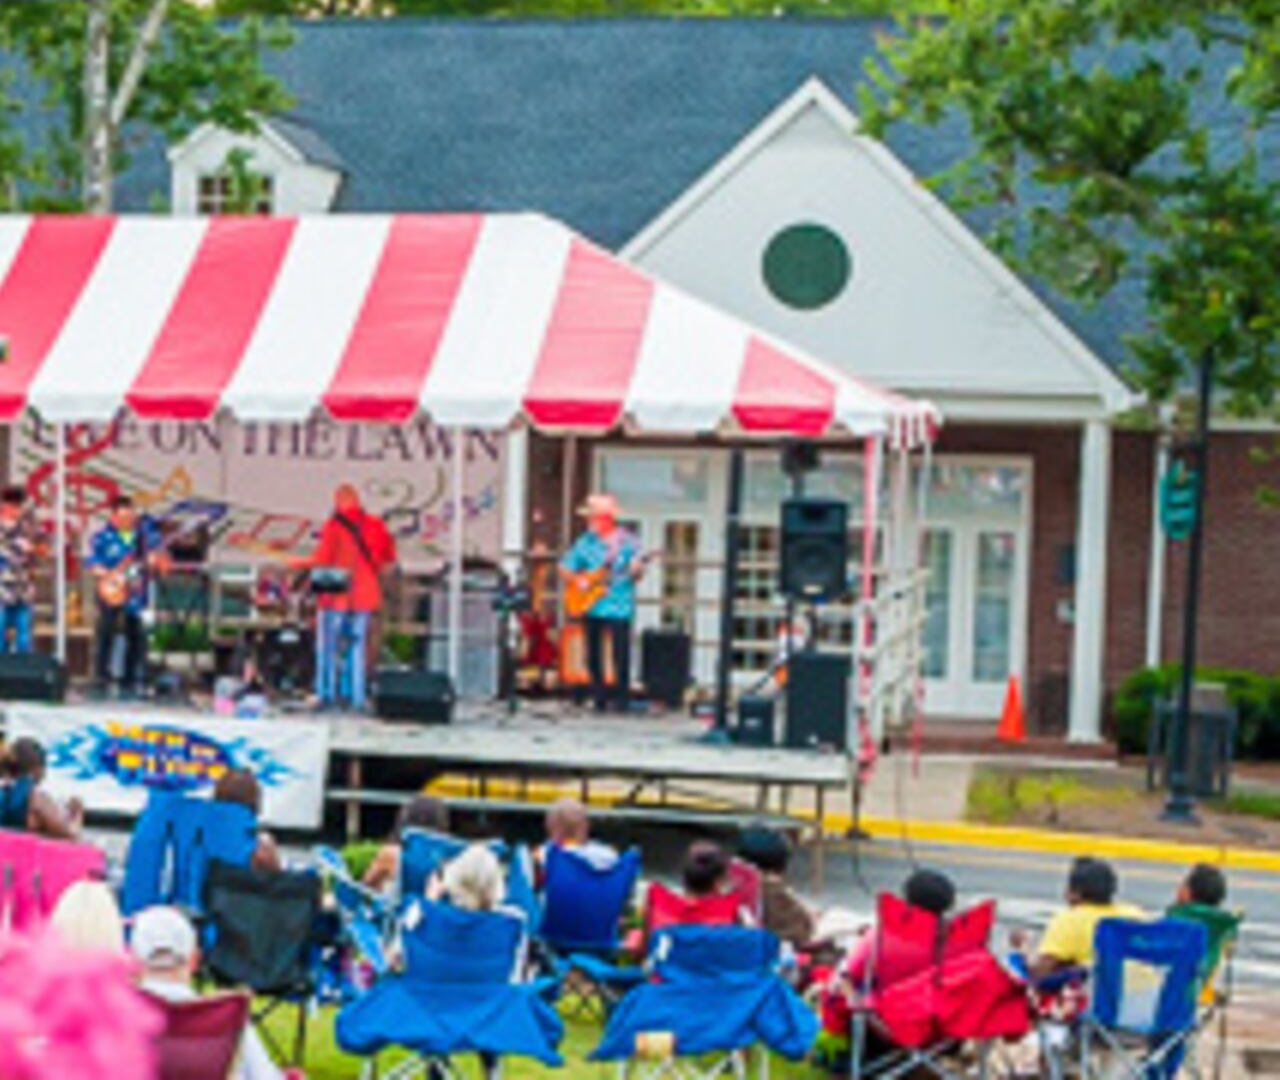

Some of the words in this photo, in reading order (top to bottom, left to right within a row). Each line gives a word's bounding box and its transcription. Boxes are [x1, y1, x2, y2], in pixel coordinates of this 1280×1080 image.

[148, 420, 222, 454] ON
[243, 414, 336, 459] THE
[345, 417, 502, 461] LAWN
